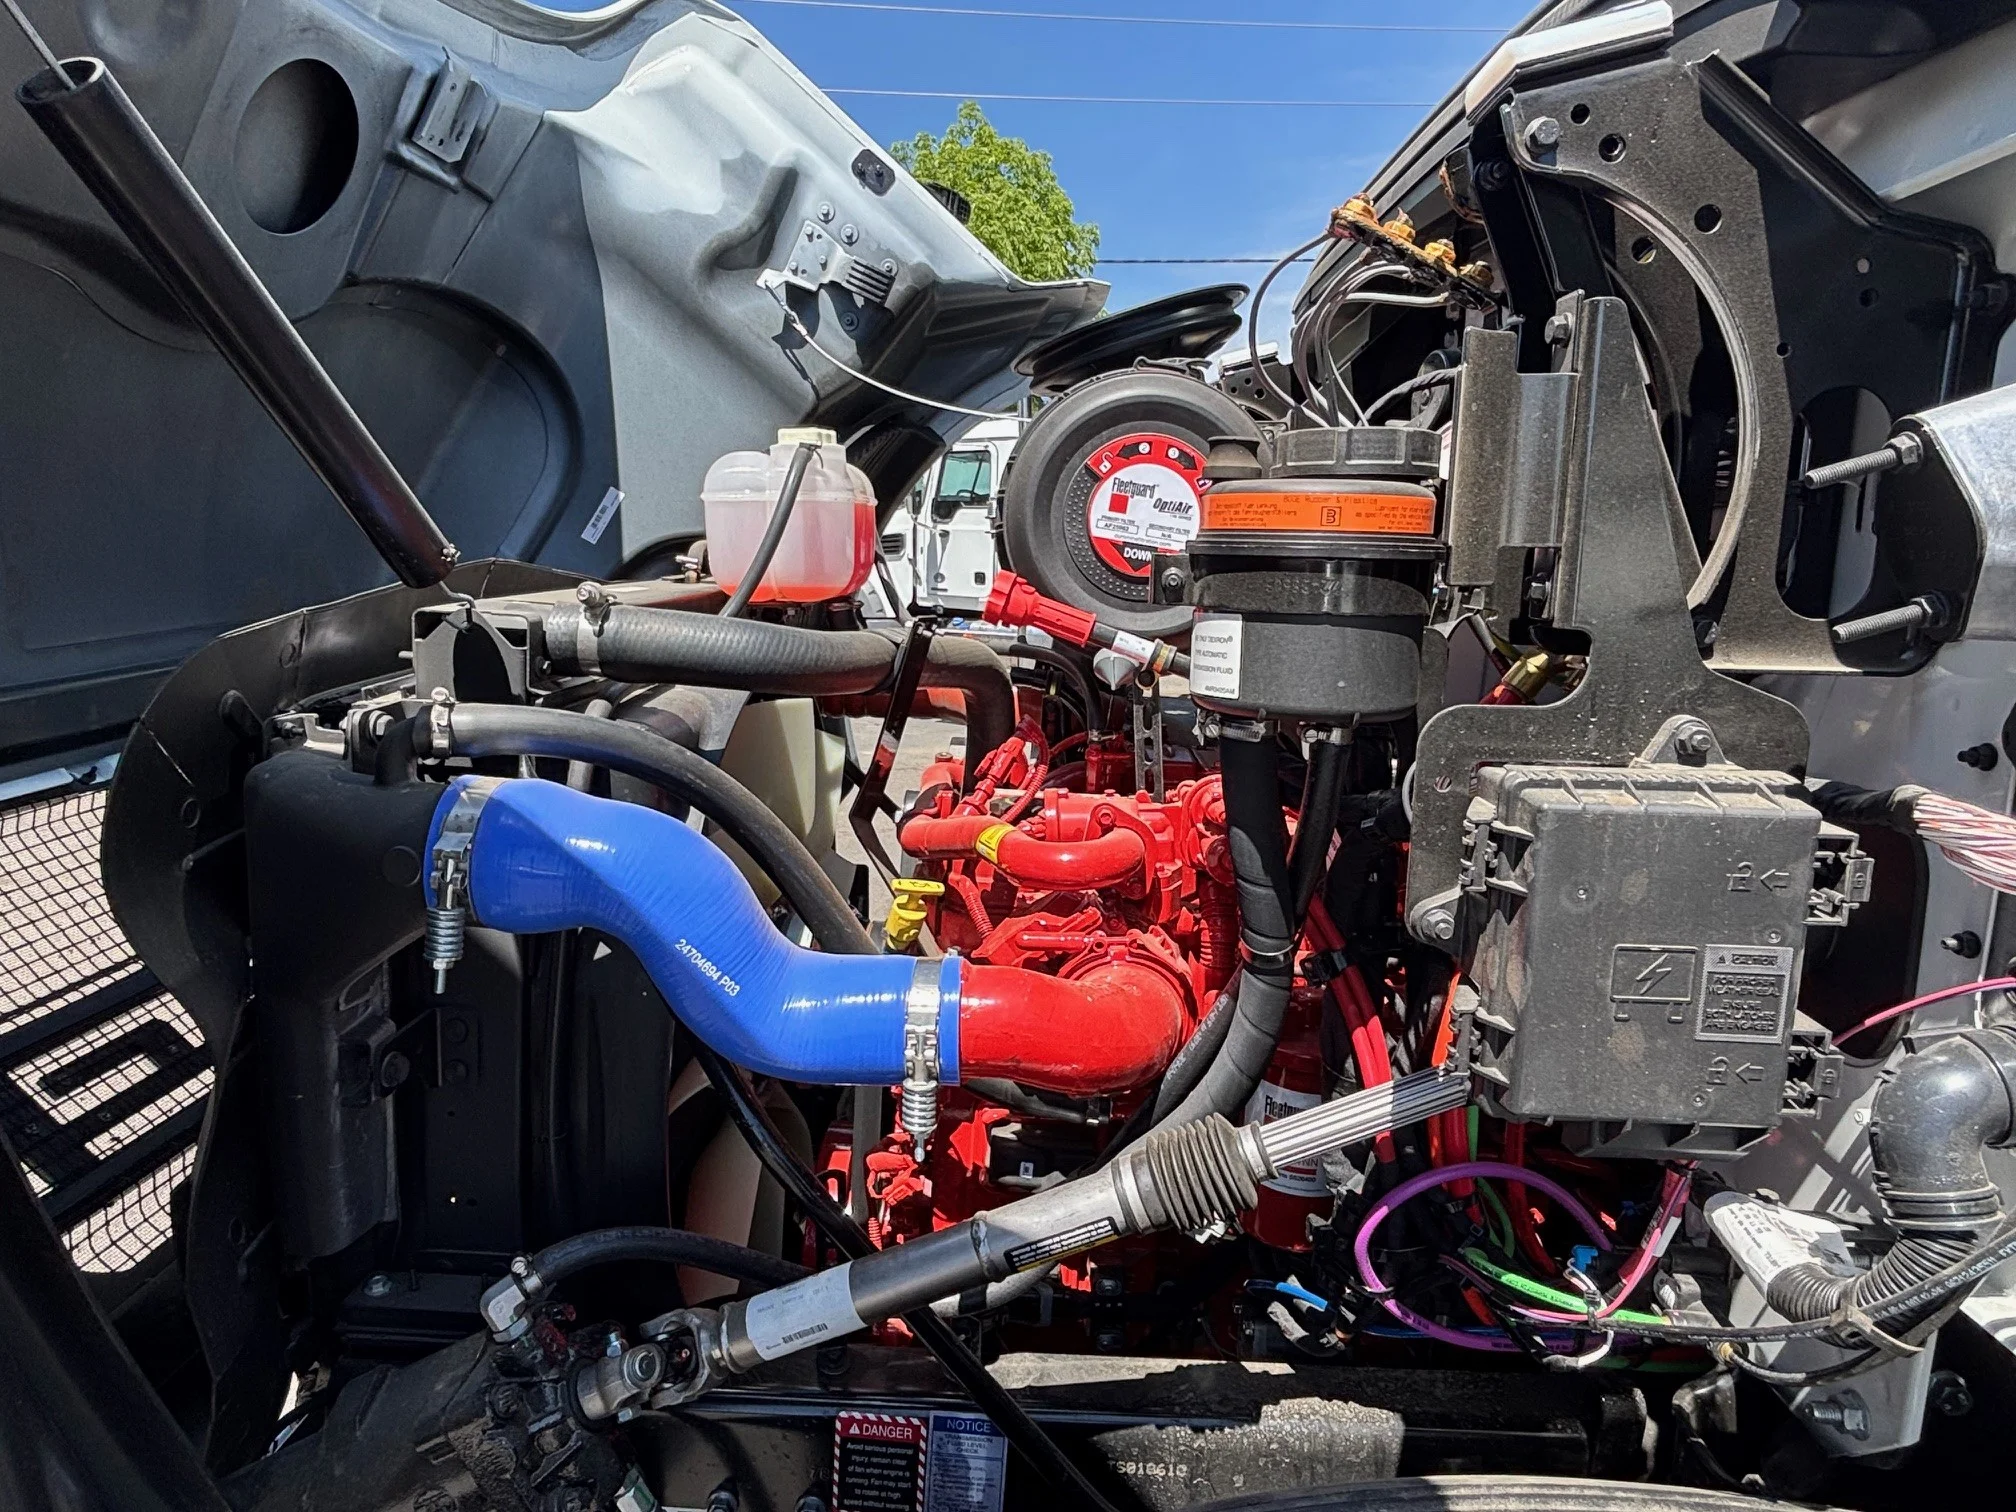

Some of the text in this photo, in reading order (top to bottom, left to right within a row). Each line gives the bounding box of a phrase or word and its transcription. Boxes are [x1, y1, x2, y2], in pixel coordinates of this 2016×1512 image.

[1140, 443, 1149, 453] 2
[675, 938, 741, 997] 24704694 P03
[1264, 1095, 1307, 1118] Fleetg
[862, 1423, 913, 1440] DANGER
[946, 1418, 993, 1433] NOTICE
